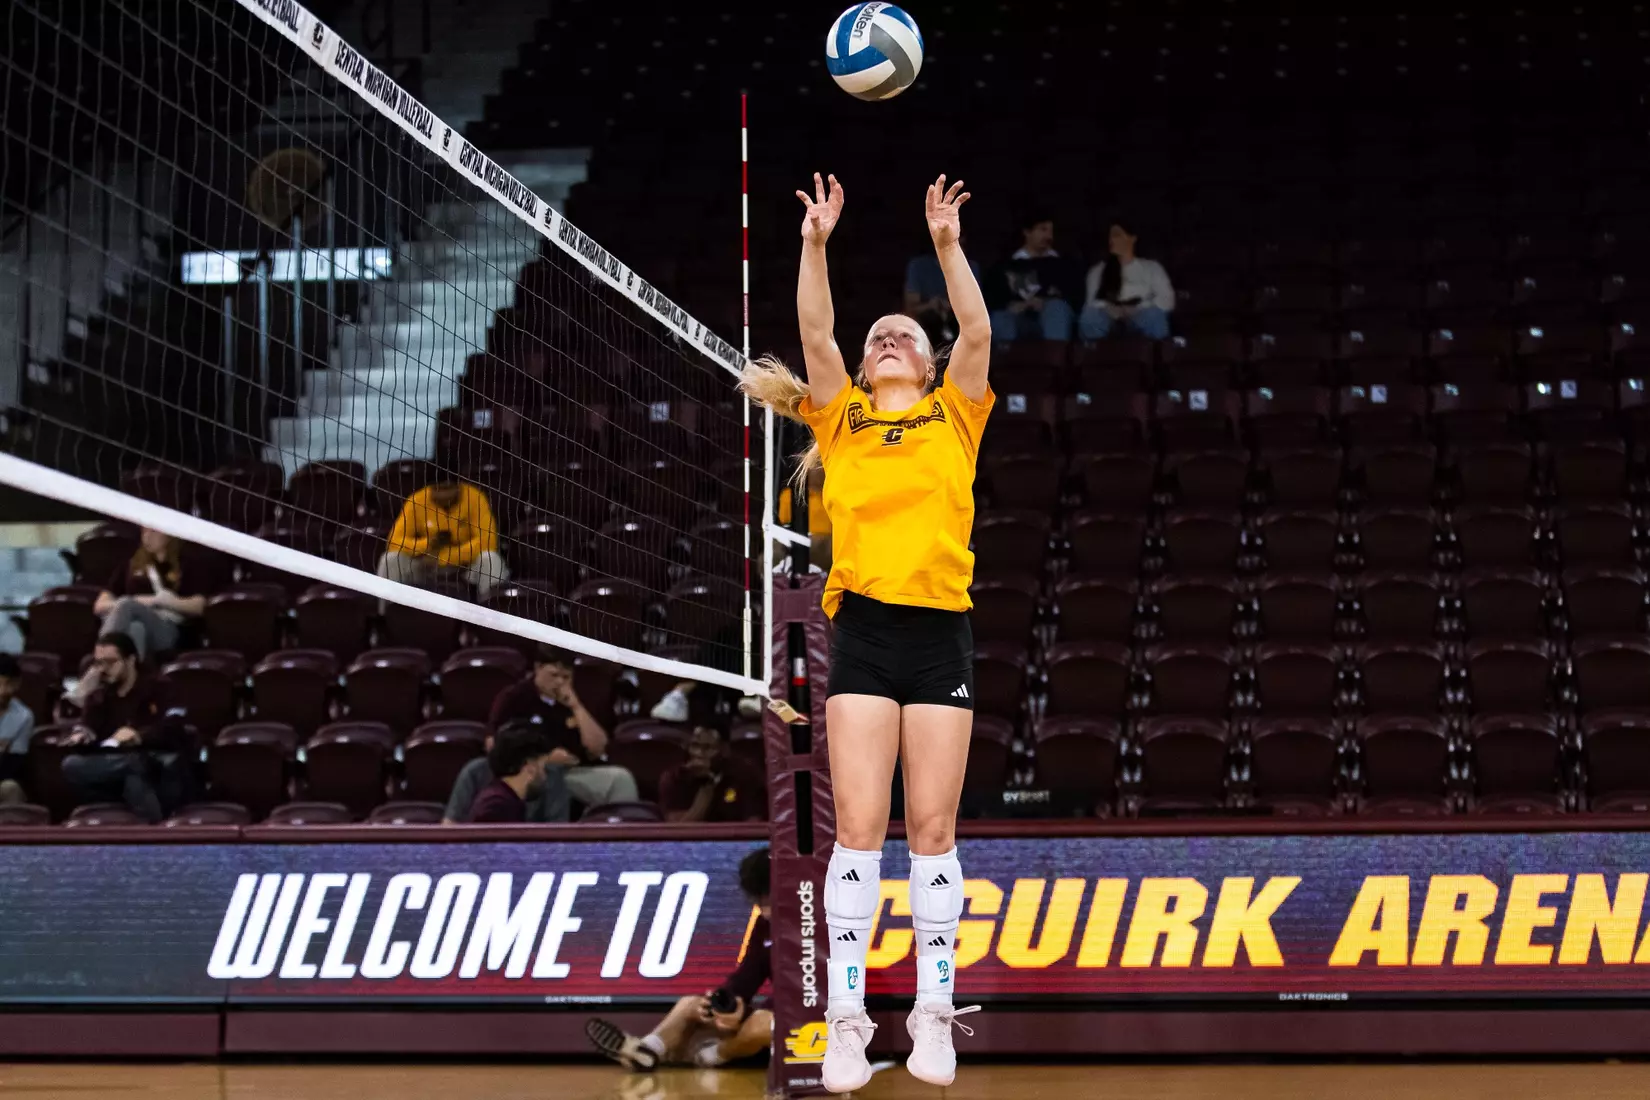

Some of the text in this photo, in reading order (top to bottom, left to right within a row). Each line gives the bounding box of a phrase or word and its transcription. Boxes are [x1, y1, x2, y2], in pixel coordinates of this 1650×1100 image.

[853, 2, 882, 38] molten
[207, 872, 599, 979] WELCOME
[600, 871, 709, 979] TO
[866, 877, 1302, 968] CGUIRK
[797, 880, 818, 1007] sports imports
[1279, 992, 1349, 1001] DAKTRONICS
